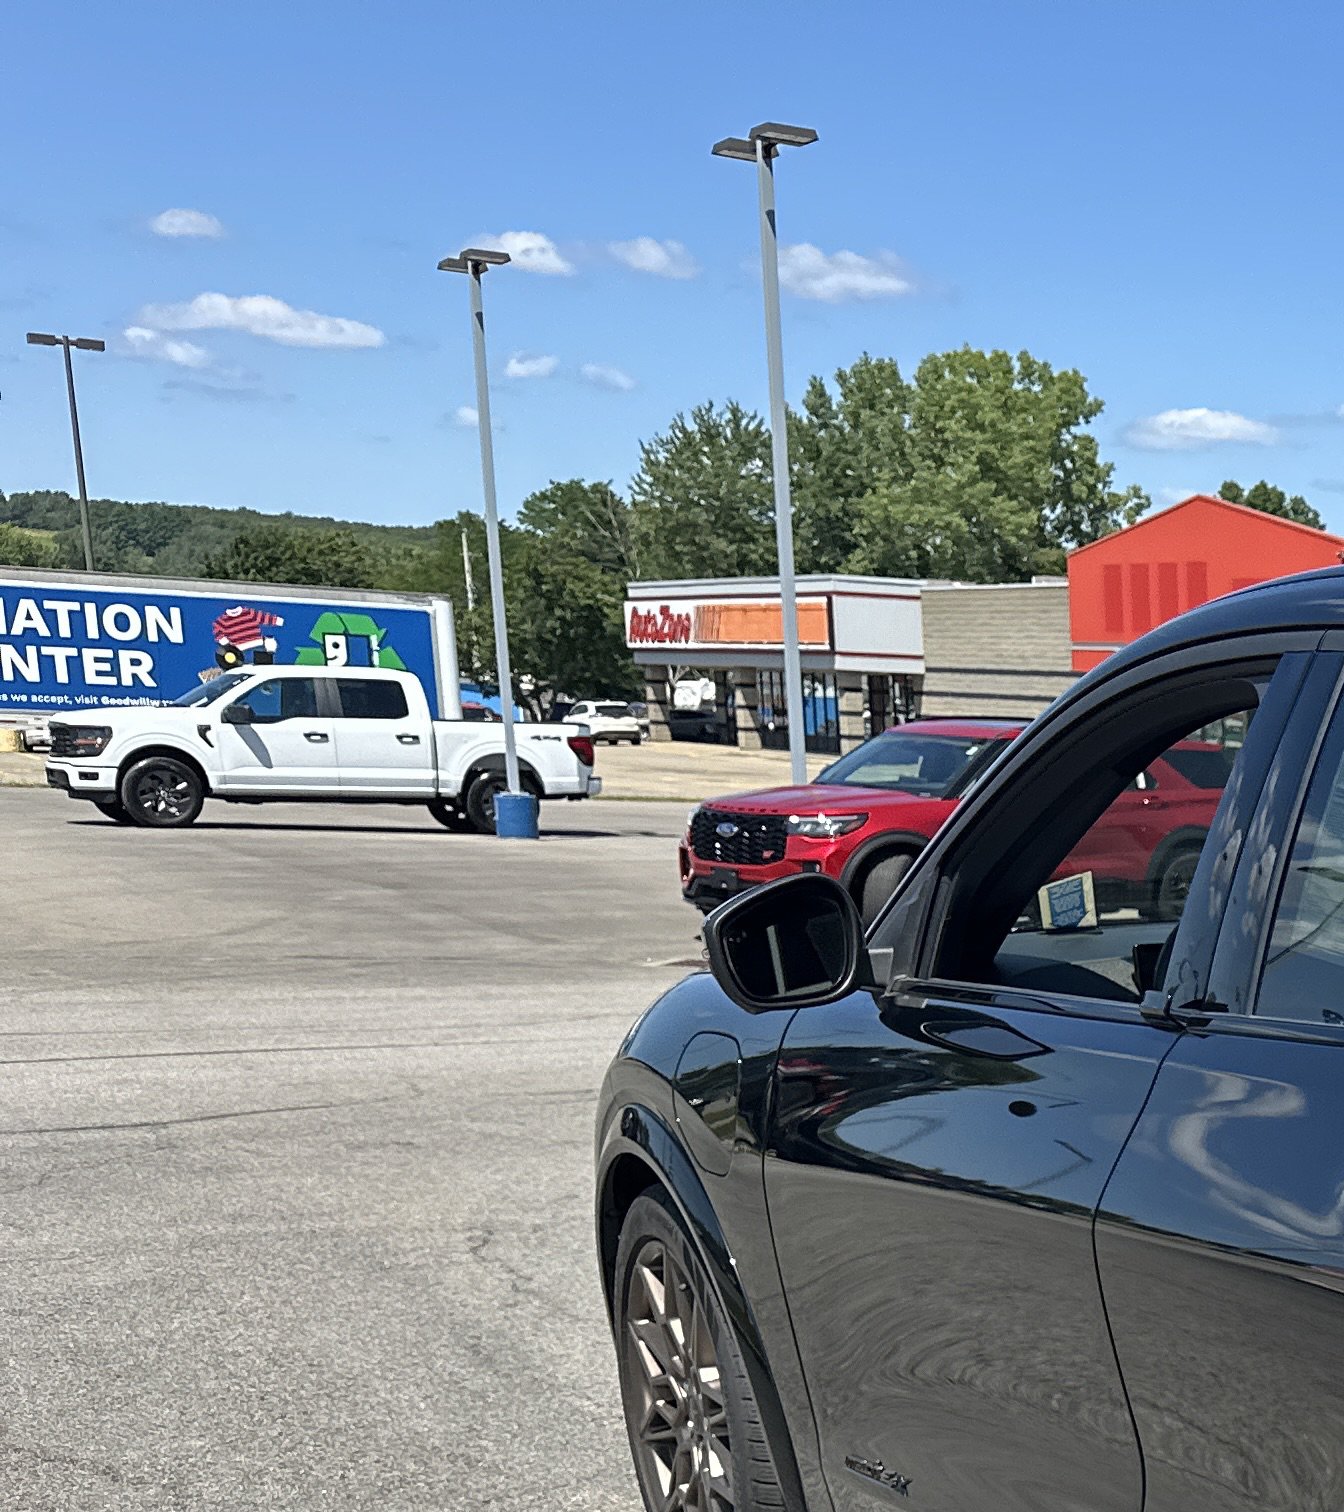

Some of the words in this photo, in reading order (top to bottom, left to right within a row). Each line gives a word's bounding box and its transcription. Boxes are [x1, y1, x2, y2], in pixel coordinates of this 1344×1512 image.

[0, 597, 184, 644] ATION
[11, 694, 28, 702] we
[31, 694, 73, 705] accept,
[75, 695, 99, 705] visit
